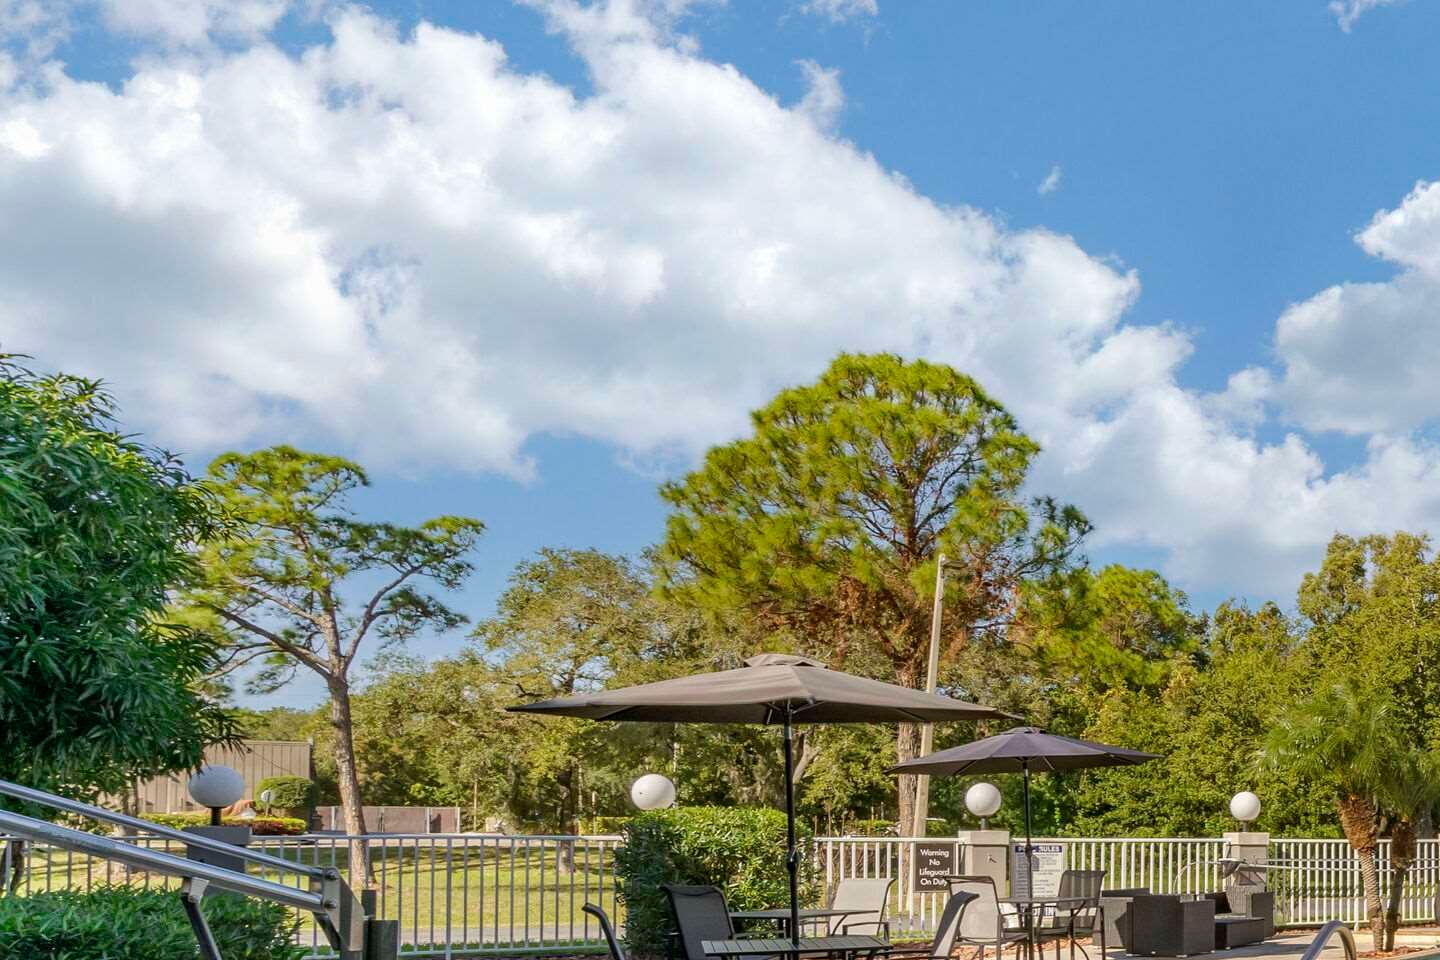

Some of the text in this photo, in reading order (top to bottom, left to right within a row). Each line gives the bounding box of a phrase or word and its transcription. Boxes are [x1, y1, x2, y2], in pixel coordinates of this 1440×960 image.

[920, 848, 950, 858] Warning
[928, 858, 941, 866] No
[919, 868, 950, 877] Lifeguard
[920, 878, 932, 886] On
